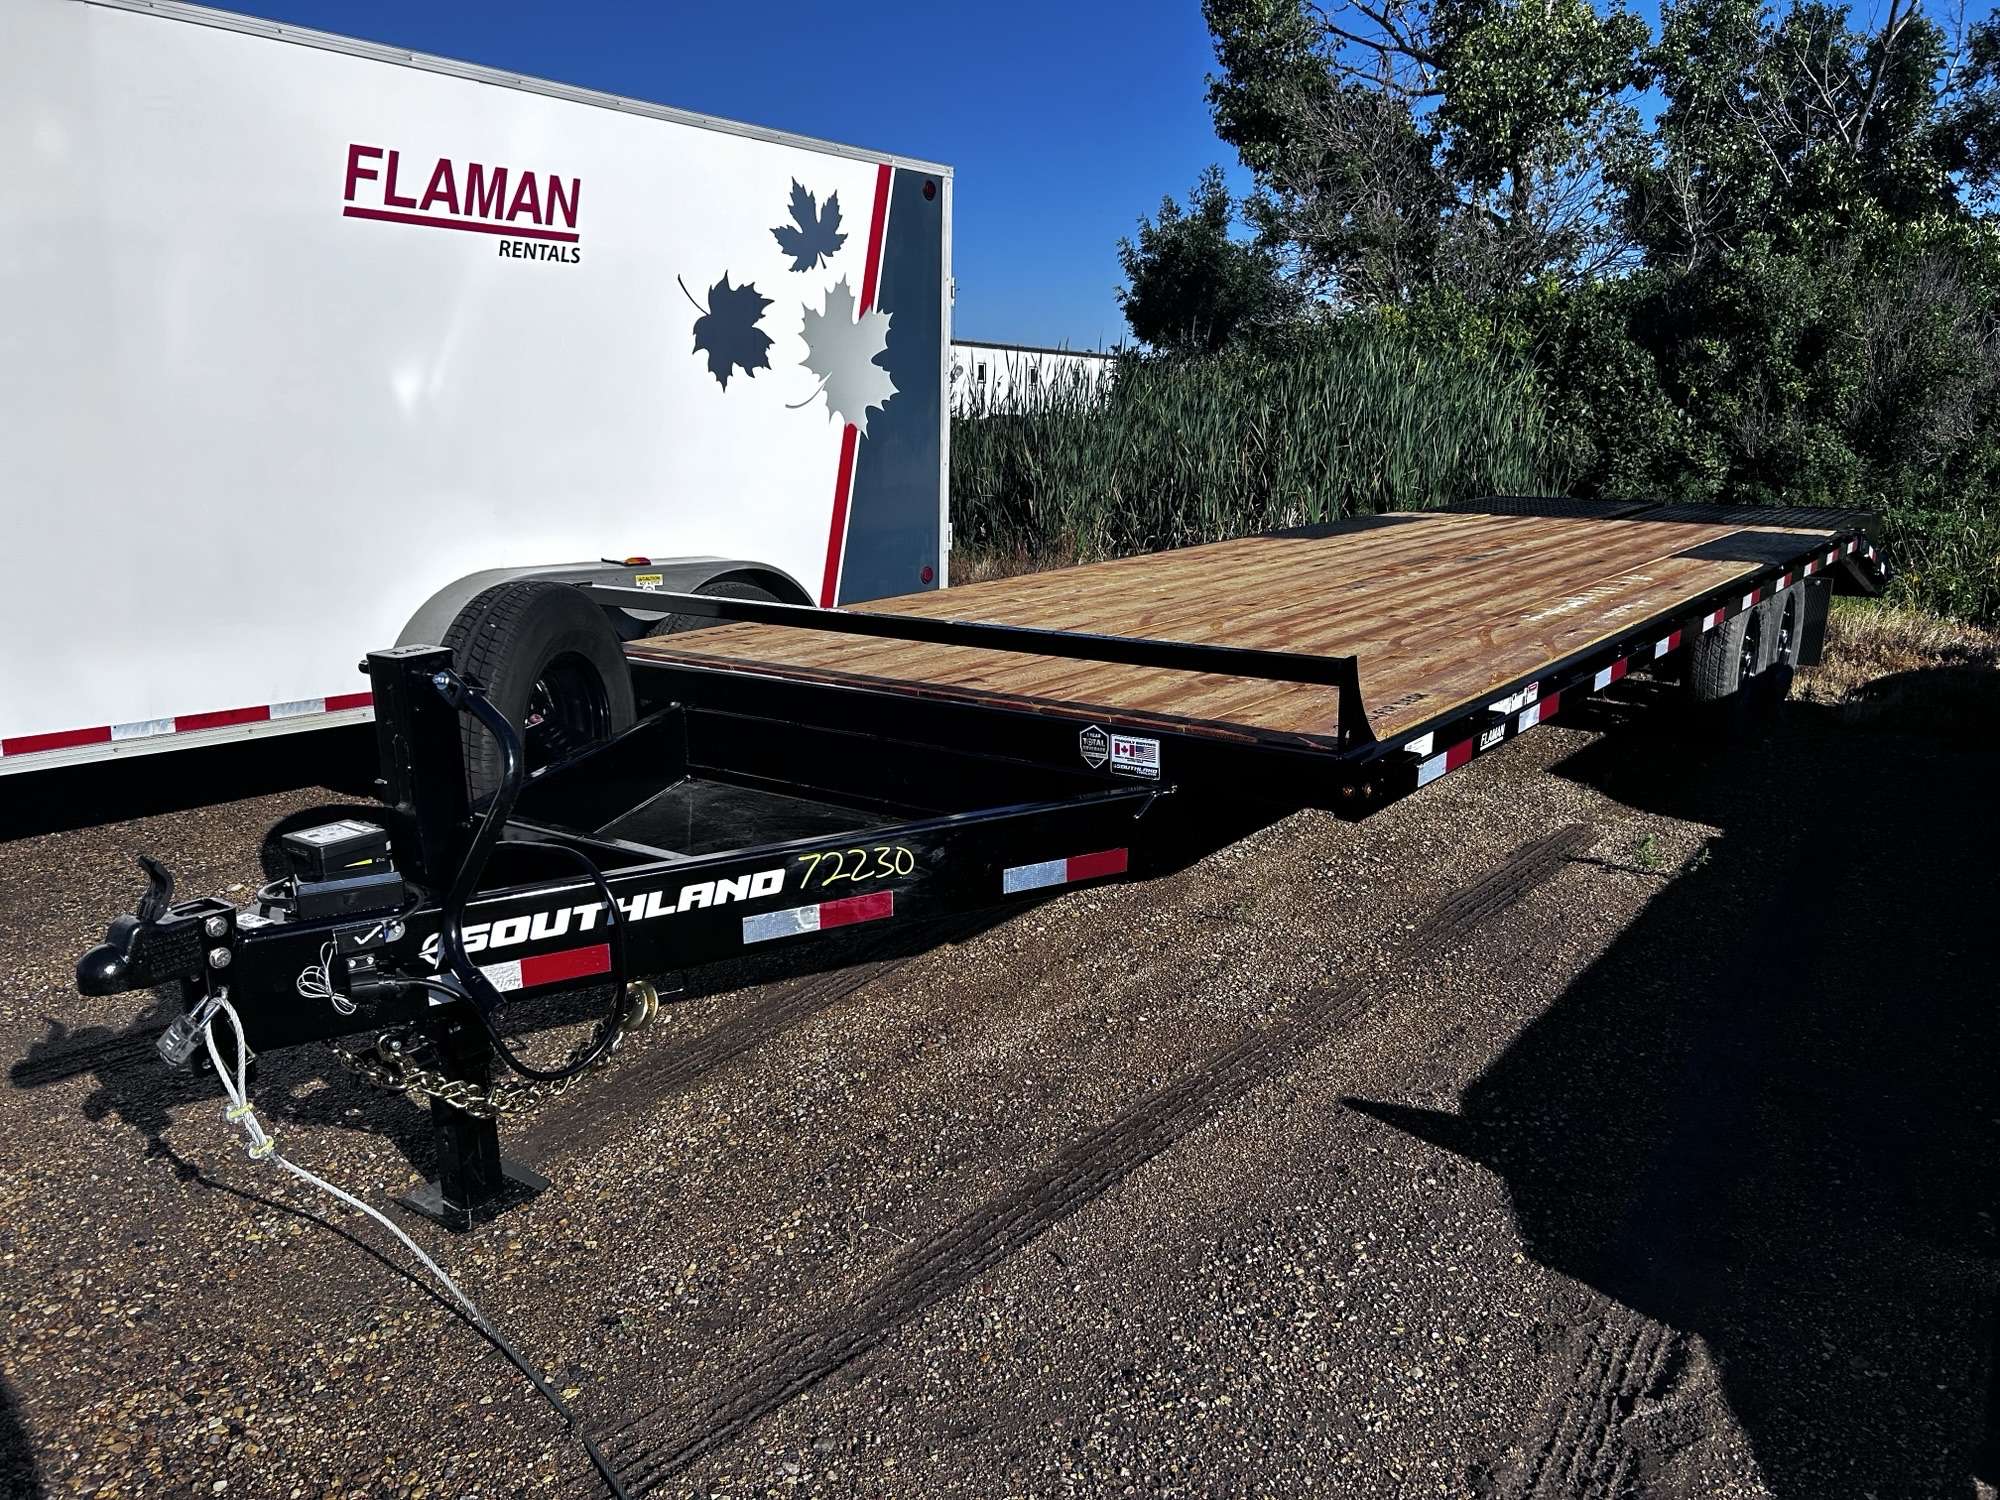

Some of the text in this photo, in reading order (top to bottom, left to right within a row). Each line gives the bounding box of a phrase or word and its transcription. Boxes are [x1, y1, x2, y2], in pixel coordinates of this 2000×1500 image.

[344, 143, 581, 229] FLAMAN
[499, 239, 581, 264] RENTALS
[1082, 737, 1106, 747] TOTAL
[1480, 722, 1506, 743] FLAMAN
[799, 845, 916, 891] 72230
[462, 867, 786, 952] SOUTHLAND
